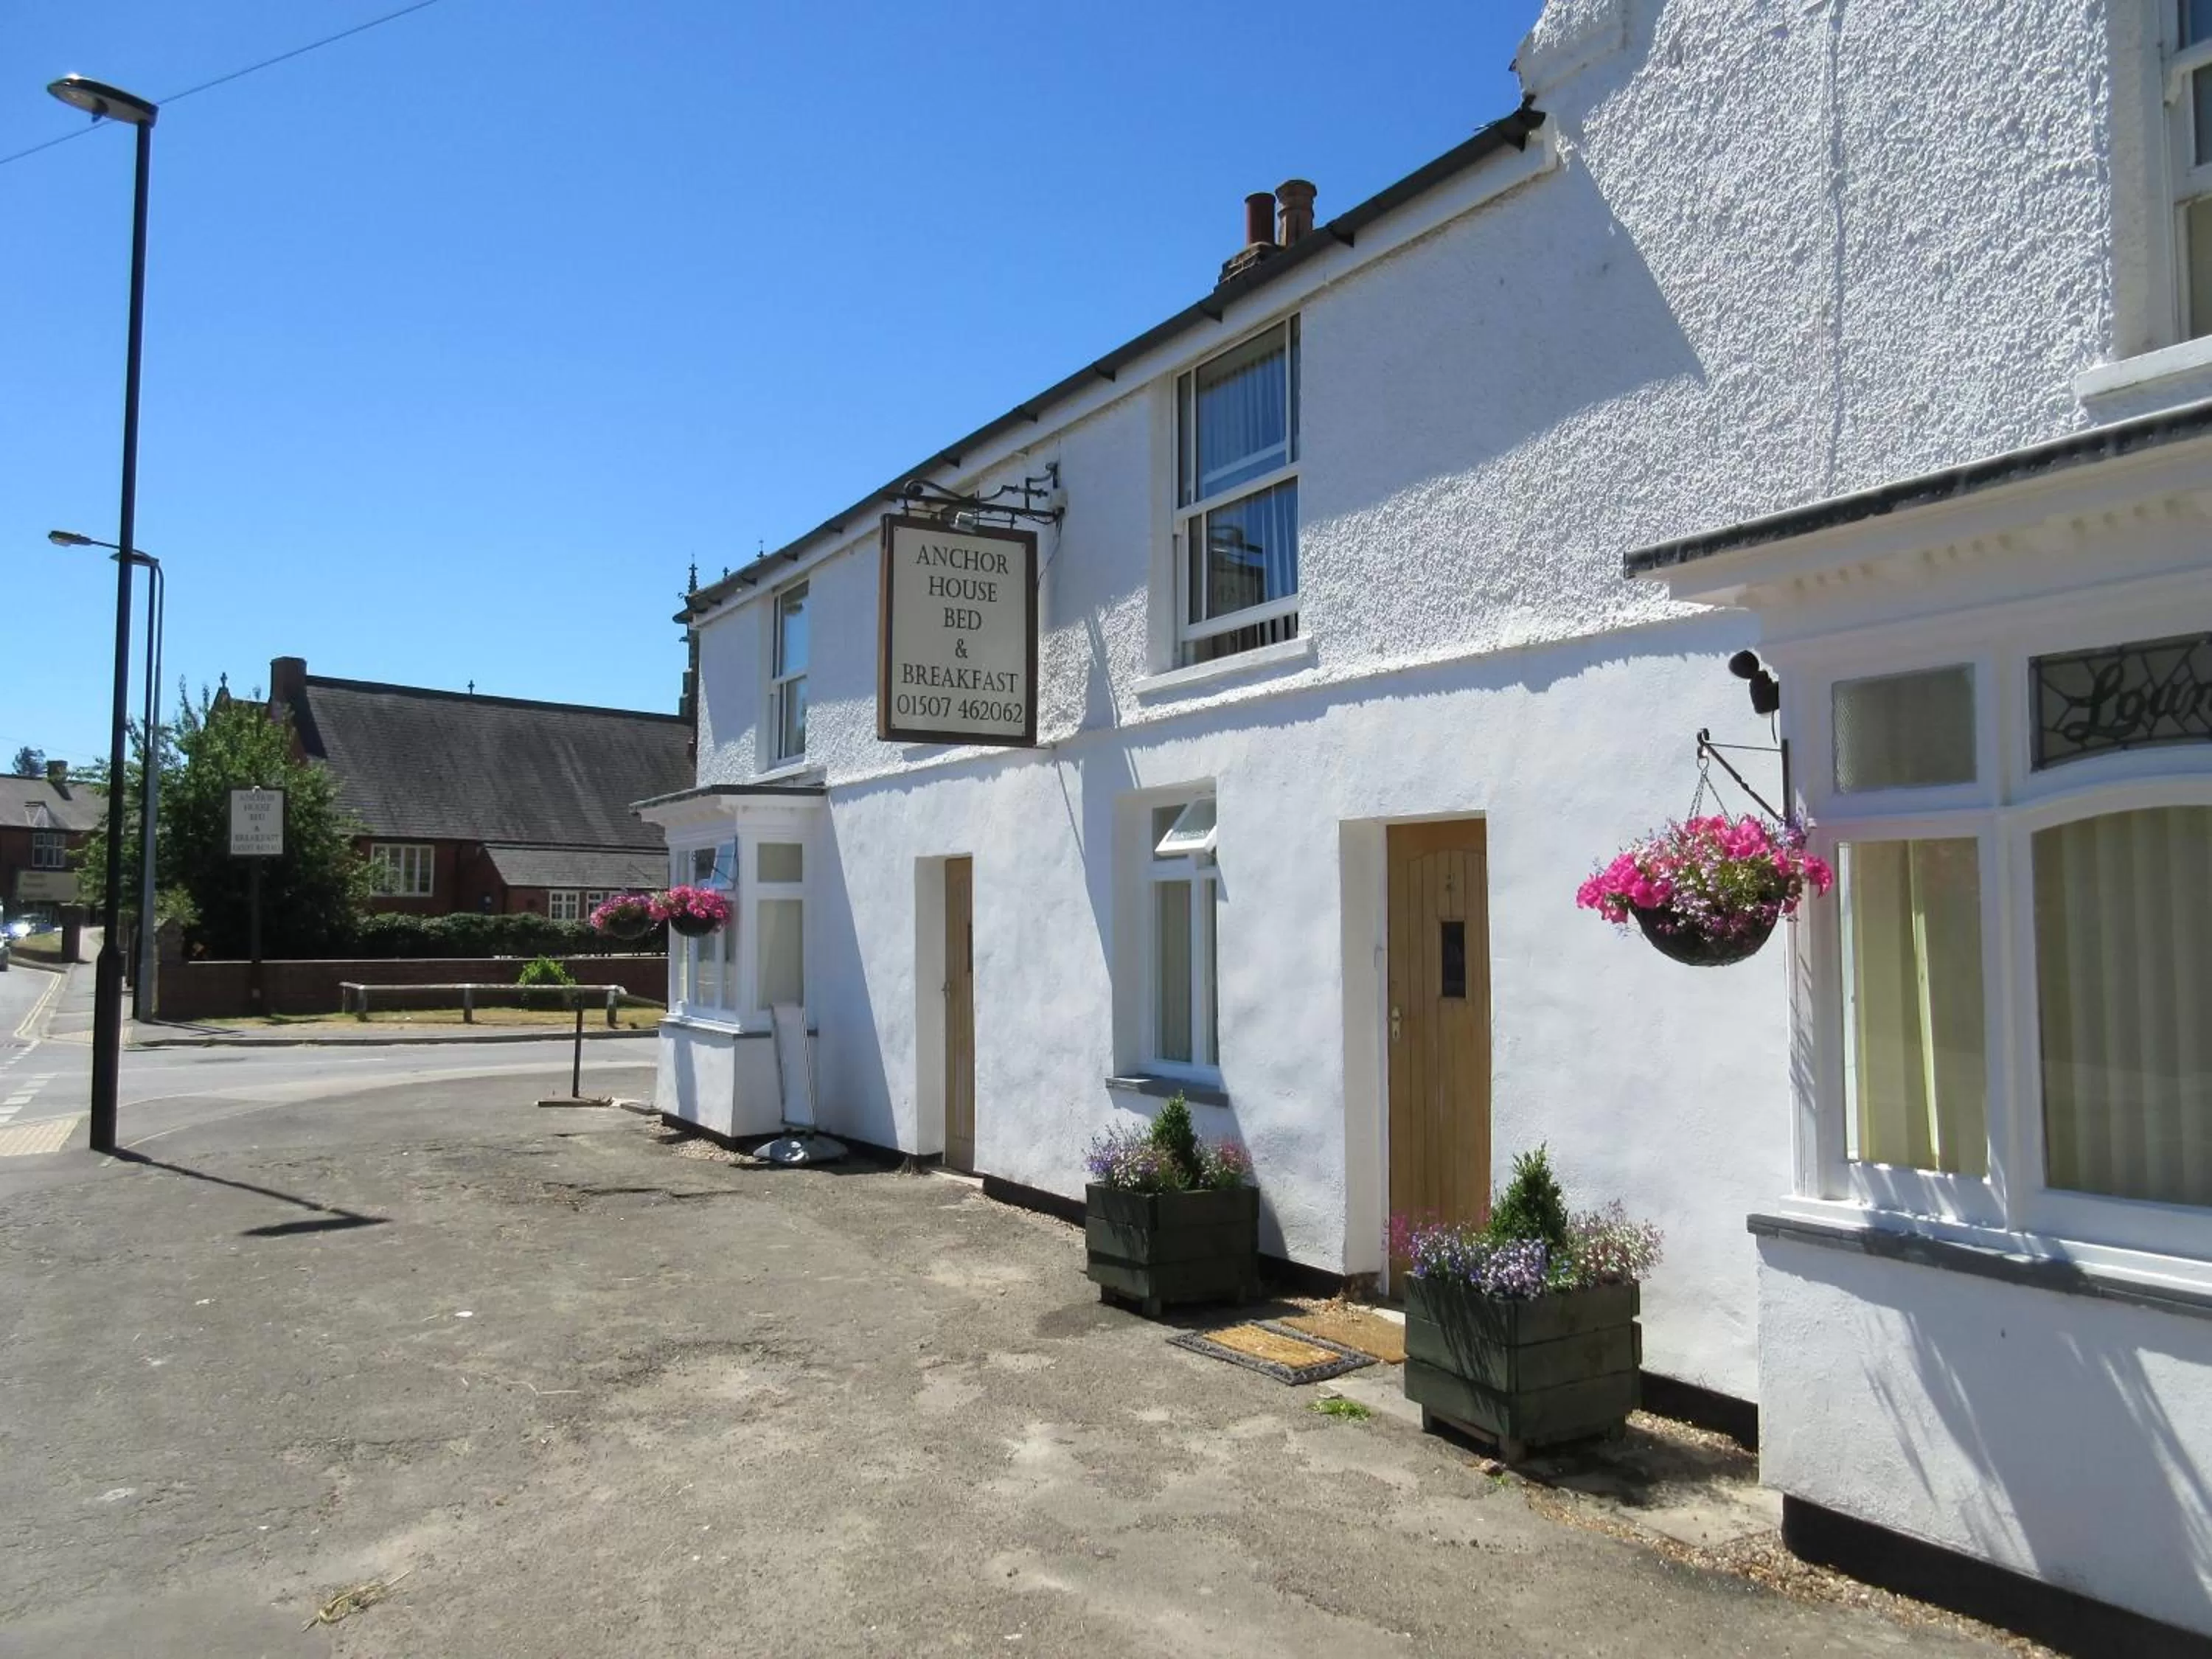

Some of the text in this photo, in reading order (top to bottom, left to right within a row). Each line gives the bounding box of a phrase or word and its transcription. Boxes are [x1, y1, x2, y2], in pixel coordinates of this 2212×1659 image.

[915, 545, 1009, 574] ANCHOR
[928, 575, 998, 602] HOUSE
[943, 607, 982, 630] BED
[955, 638, 968, 658] &
[901, 663, 1018, 693] BREAKFAST
[897, 694, 1023, 723] 01507 462062
